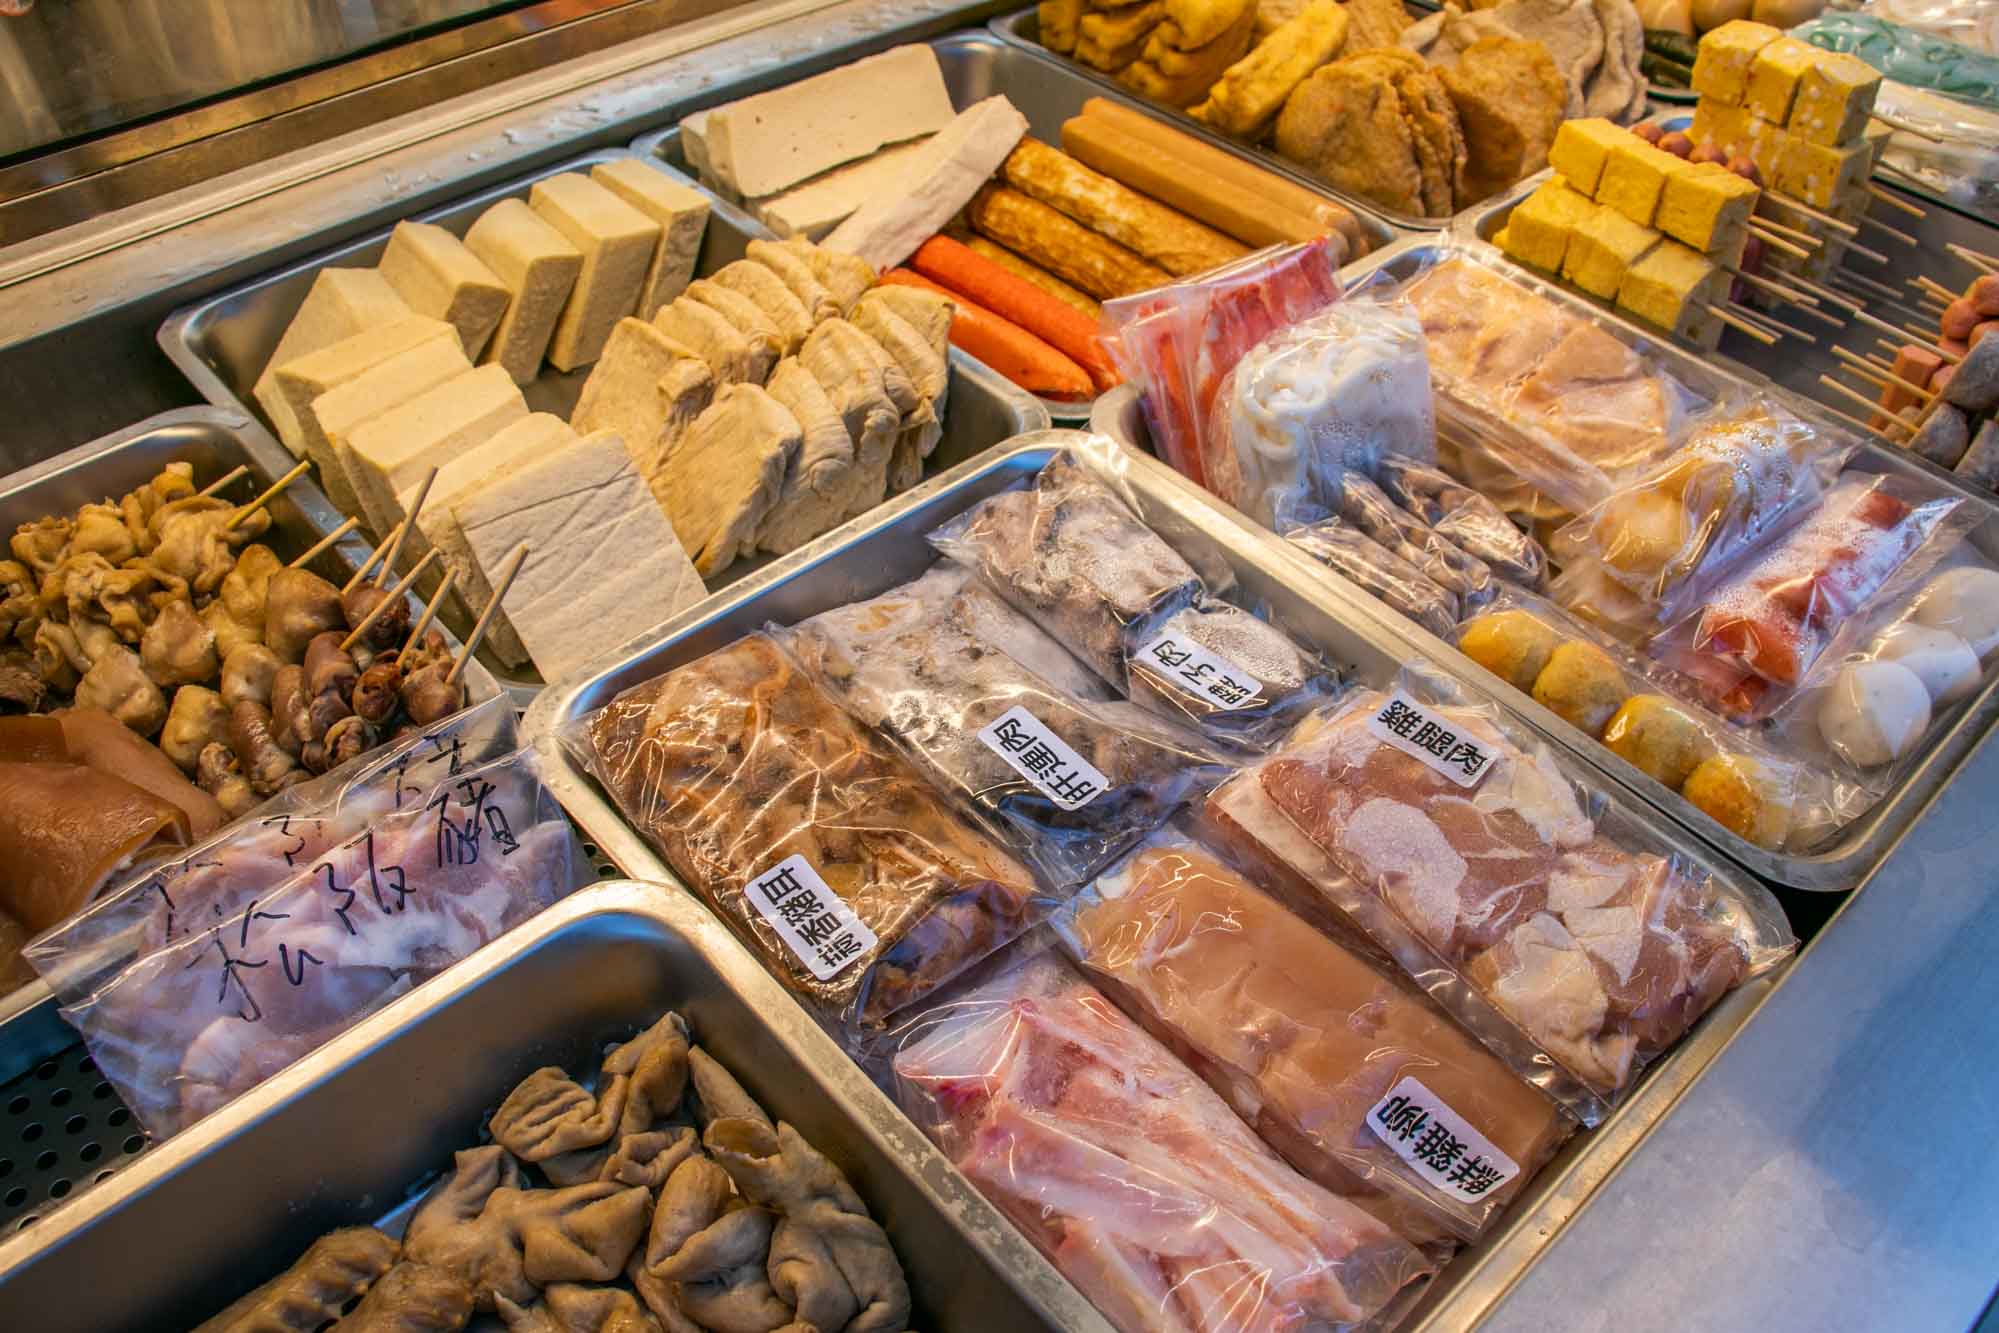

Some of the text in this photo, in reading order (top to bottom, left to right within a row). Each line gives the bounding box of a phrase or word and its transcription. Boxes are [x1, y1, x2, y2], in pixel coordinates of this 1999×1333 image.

[1151, 640, 1252, 704] 腱子肉
[993, 718, 1097, 804] 肝連肉
[1377, 699, 1488, 776] 雞腿肉
[758, 866, 863, 966] 蒜香豬耳
[1376, 1096, 1505, 1195] 鮮雞柳
